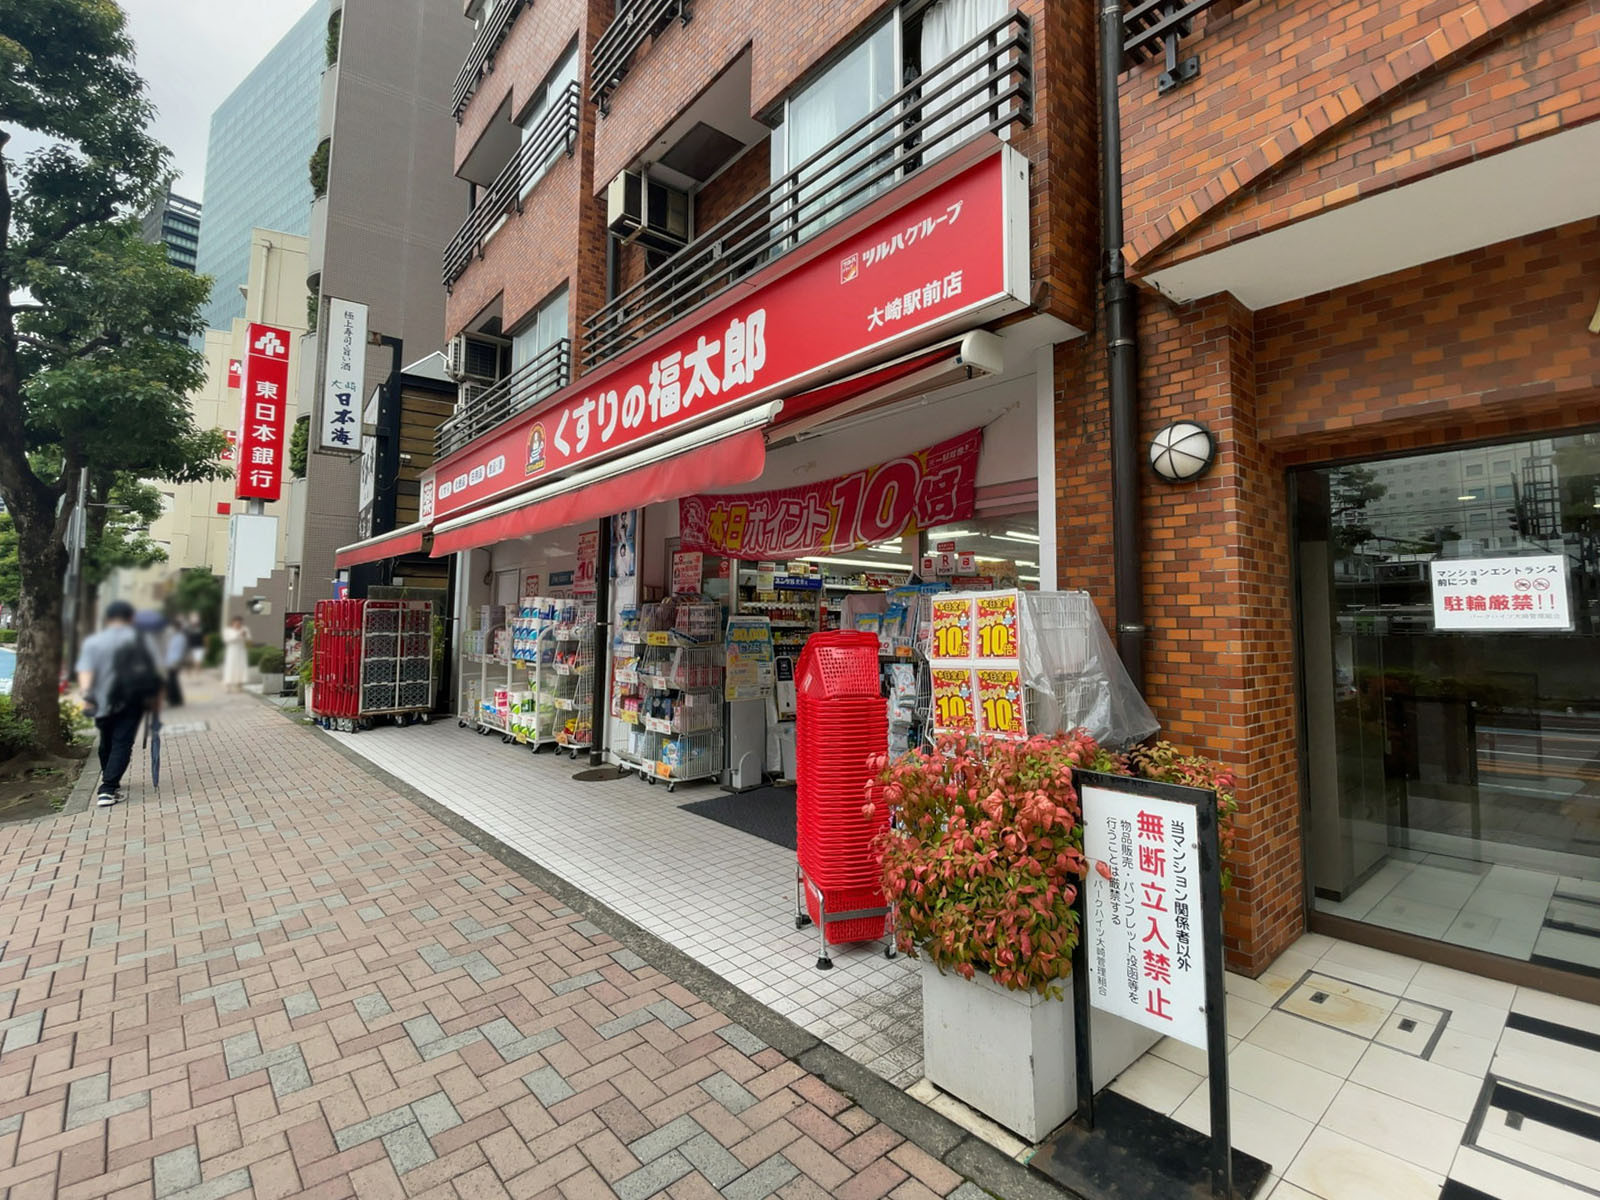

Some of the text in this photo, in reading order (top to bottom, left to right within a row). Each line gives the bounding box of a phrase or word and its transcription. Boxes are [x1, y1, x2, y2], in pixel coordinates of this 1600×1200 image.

[862, 200, 963, 268] ツルハグループ
[867, 270, 963, 332] 大崎駅前店
[330, 392, 356, 446] 日本海
[553, 308, 767, 457] くすりの福太郎
[250, 380, 279, 488] 東日本銀行
[1437, 565, 1558, 578] マンションエントランス
[1437, 578, 1478, 587] 前につき
[1106, 816, 1121, 926] 行うことは厳禁する
[1171, 819, 1192, 973] 当マンション関係者以外
[1137, 809, 1173, 1022] 無断立入禁止
